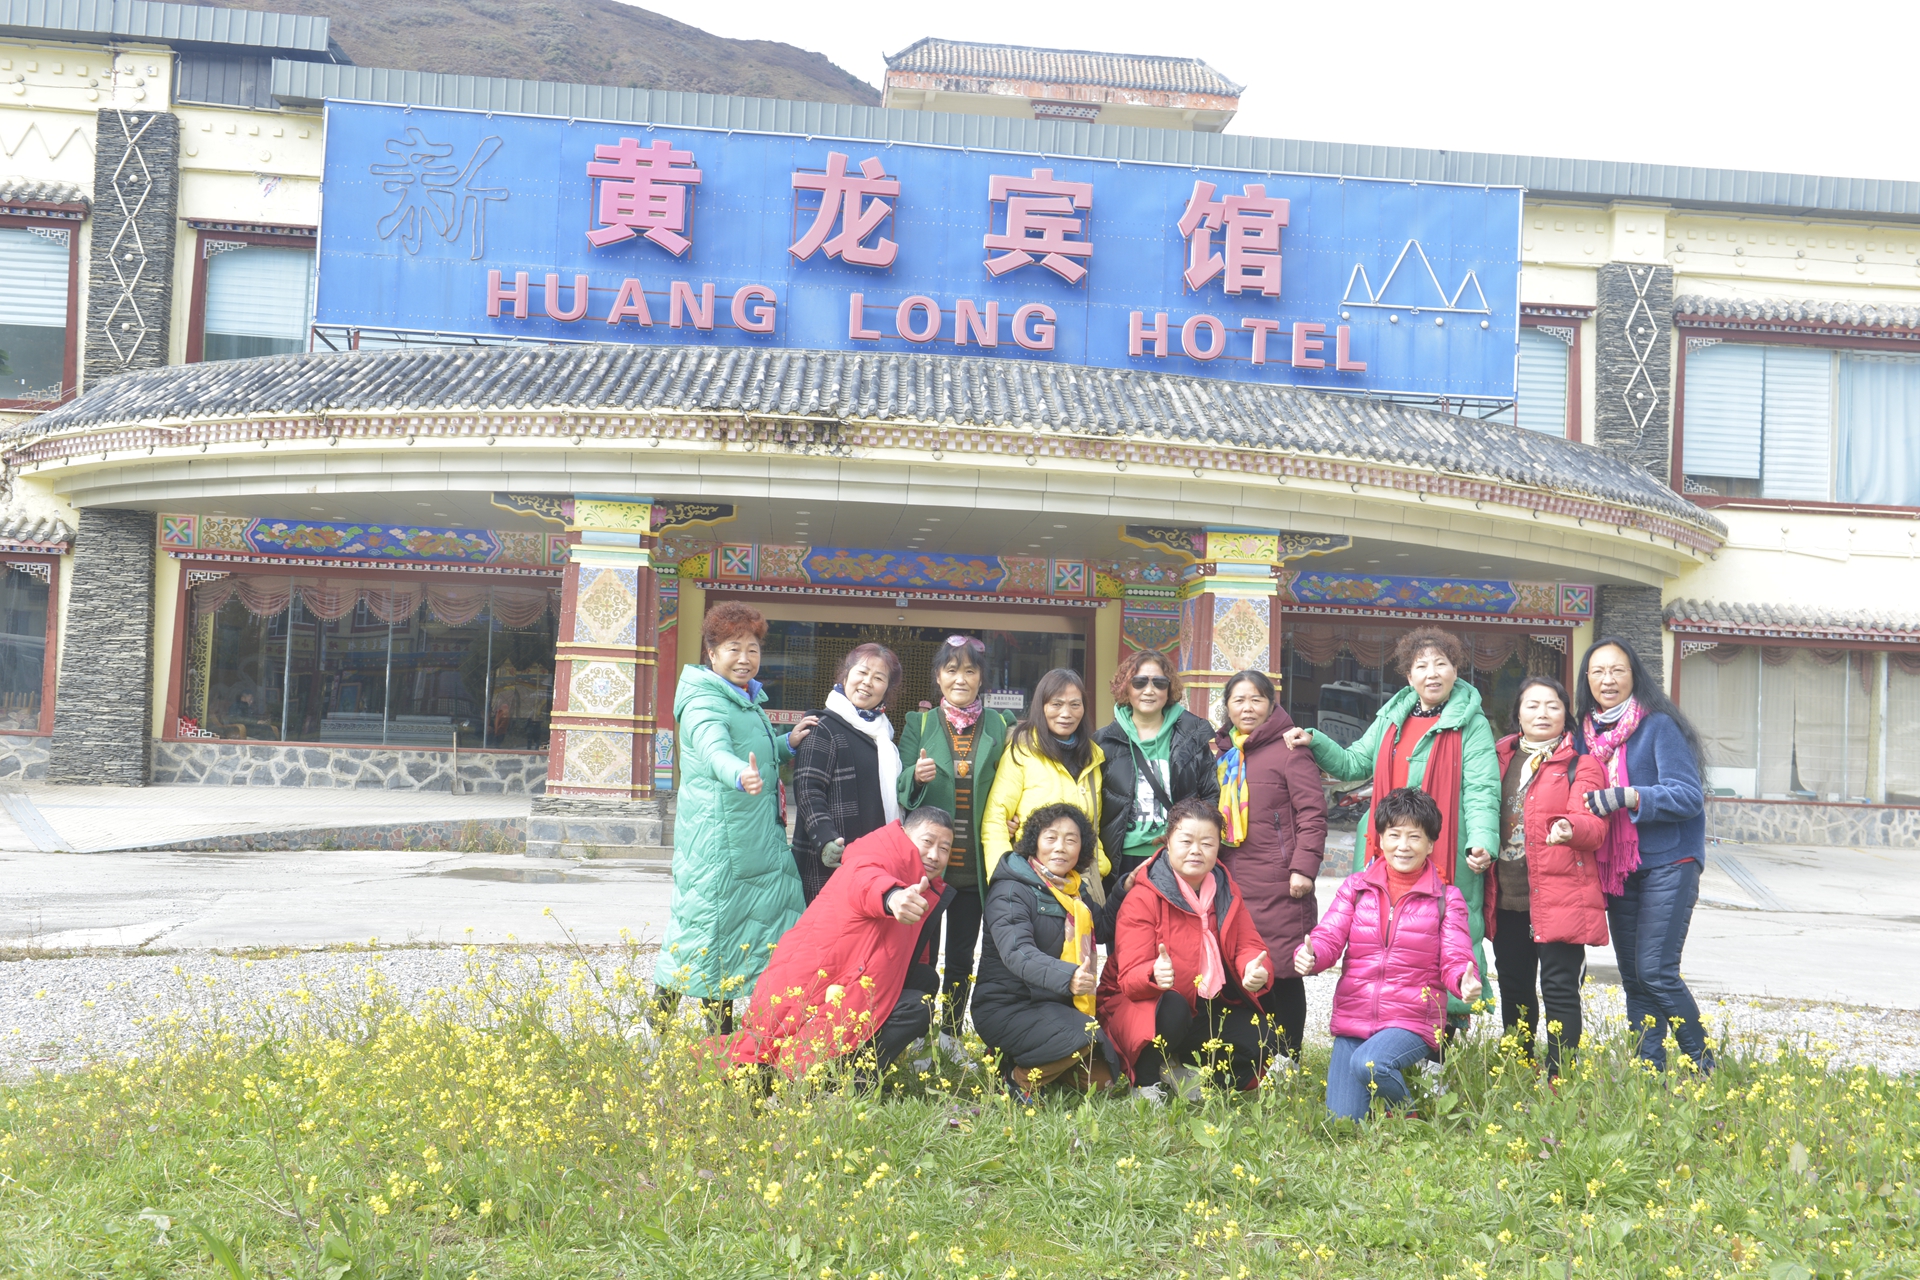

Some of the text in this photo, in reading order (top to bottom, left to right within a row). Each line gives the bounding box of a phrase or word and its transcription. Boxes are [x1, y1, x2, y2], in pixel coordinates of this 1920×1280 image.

[486, 269, 1368, 373] HUANG LONG HOTEL
